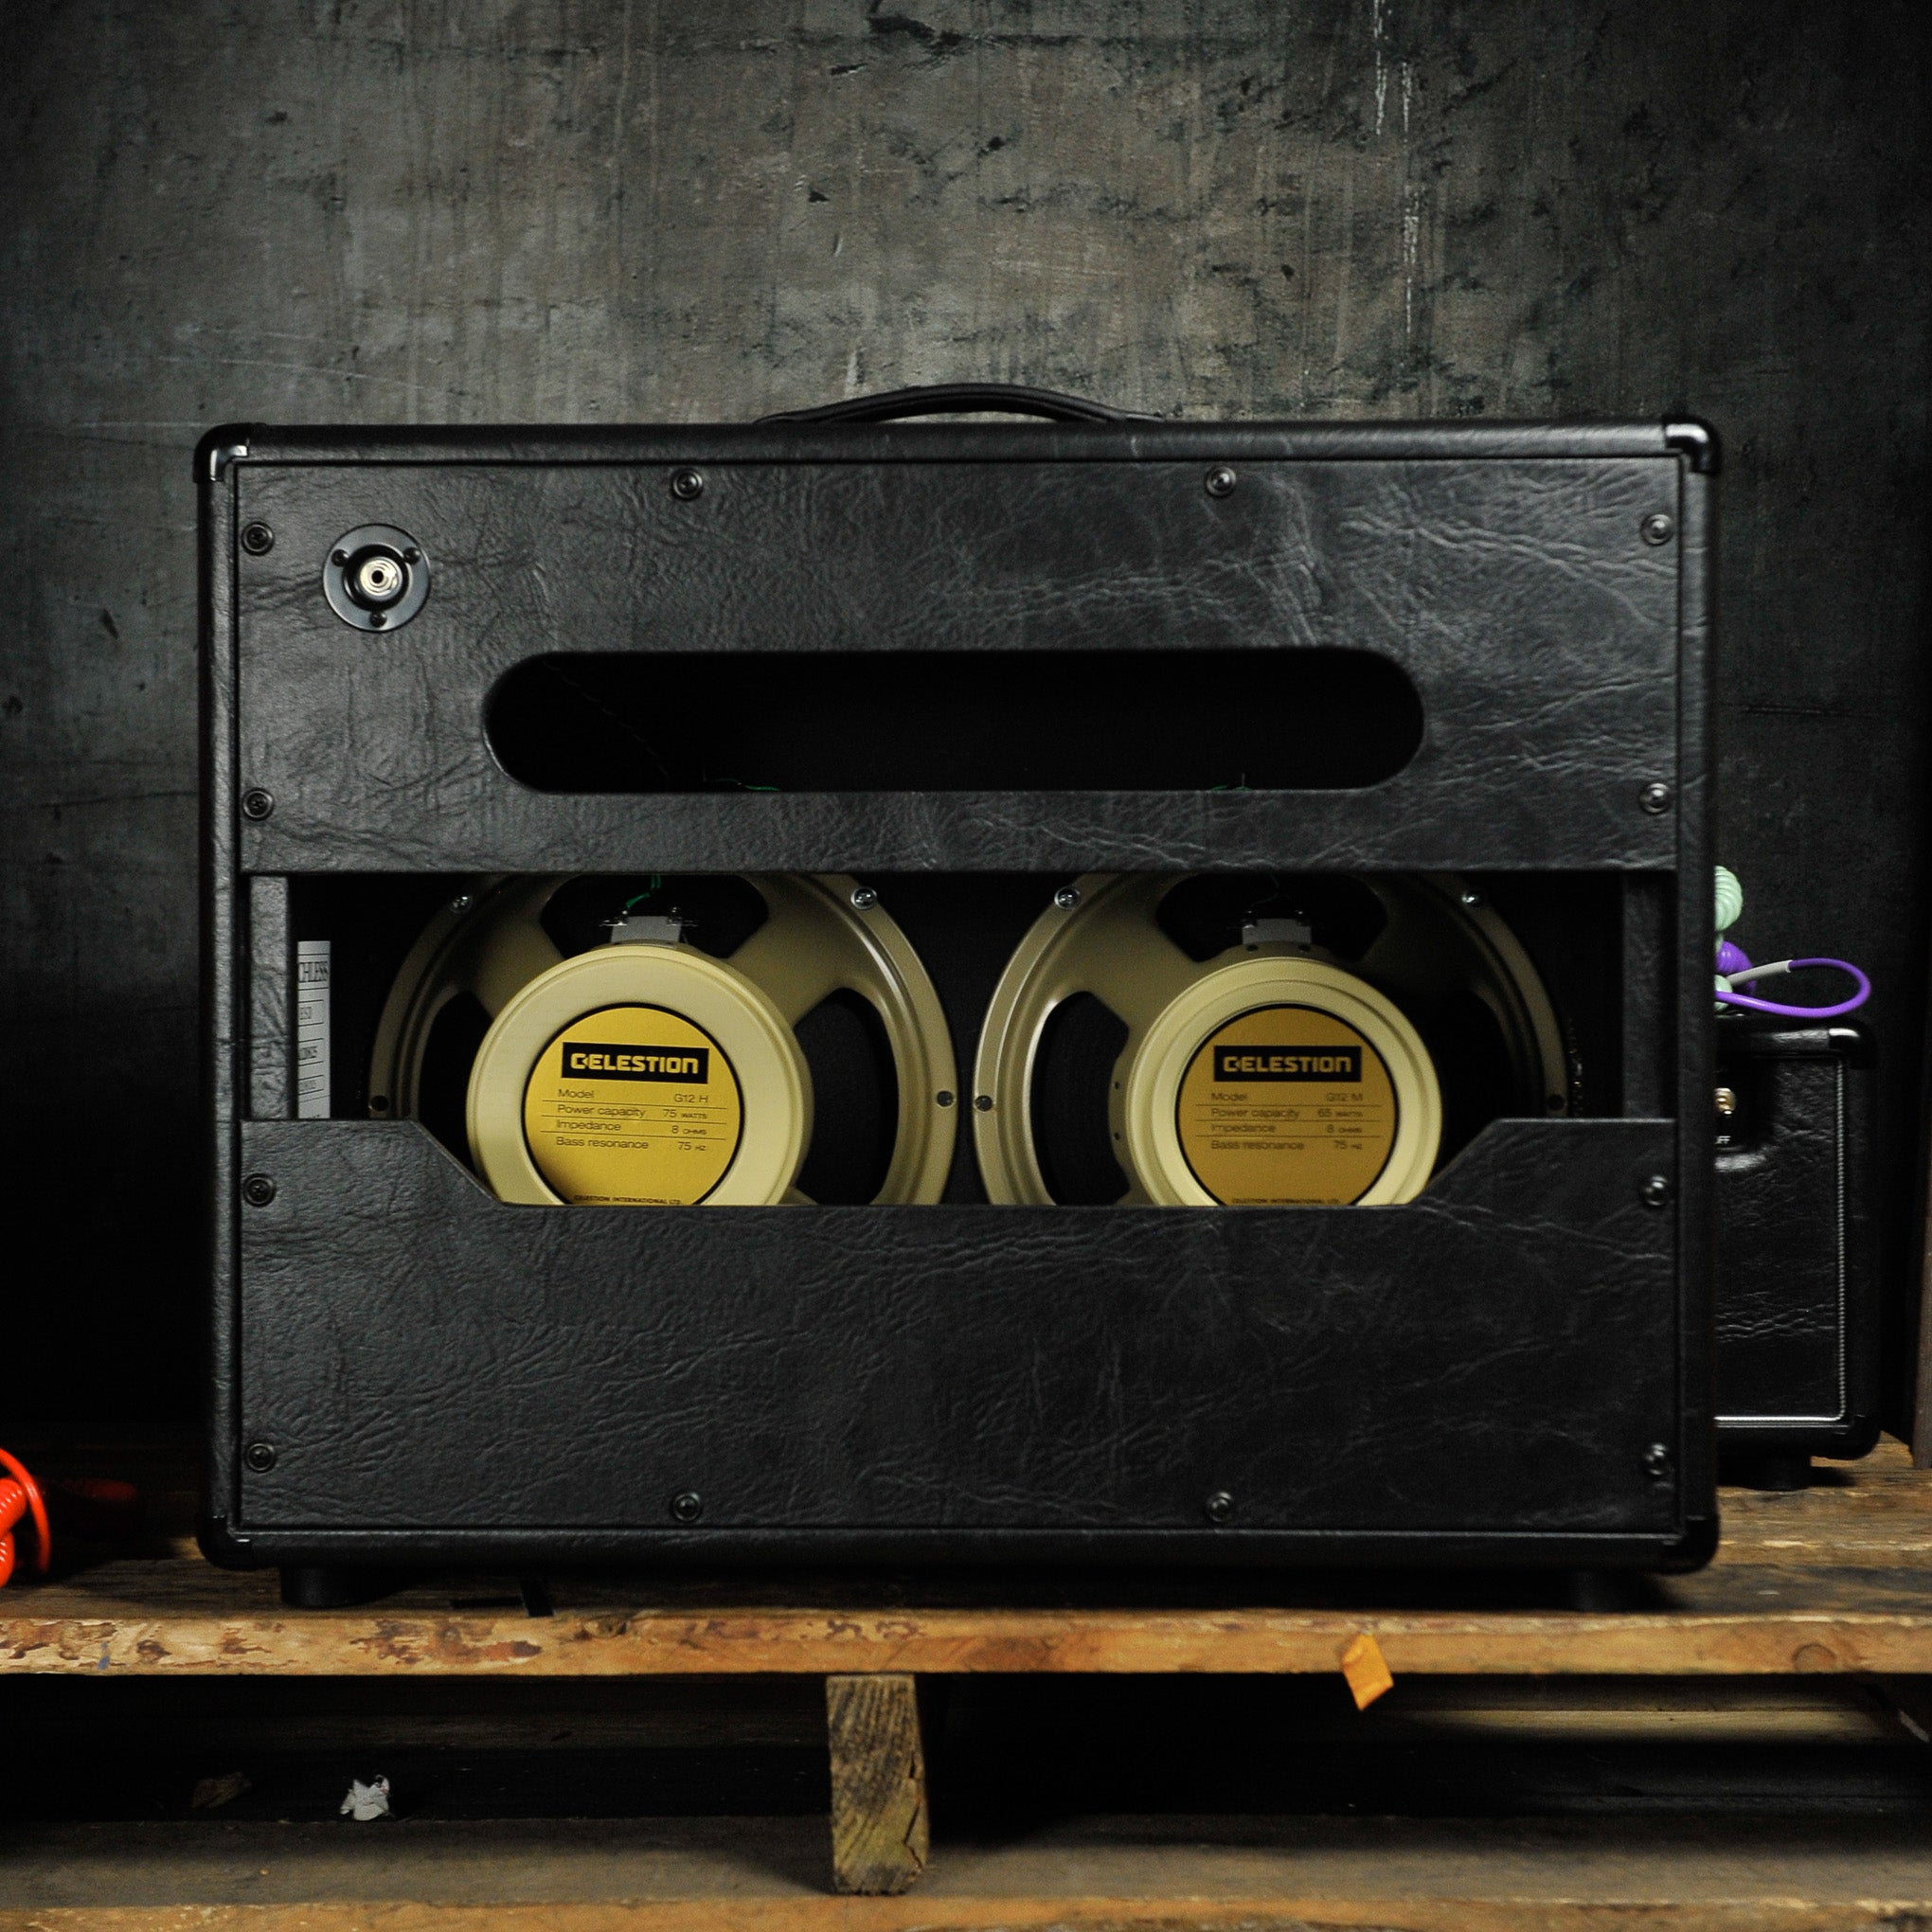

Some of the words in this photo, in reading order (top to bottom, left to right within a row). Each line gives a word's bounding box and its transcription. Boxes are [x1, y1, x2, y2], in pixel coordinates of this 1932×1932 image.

[571, 1053, 699, 1074] CELESTION
[1222, 1055, 1352, 1073] CELESTION
[557, 1089, 594, 1098] Model
[674, 1093, 695, 1103] G12
[698, 1094, 709, 1103] H
[1211, 1092, 1248, 1102] Model
[1352, 1092, 1363, 1102] M
[557, 1104, 594, 1114] Power
[597, 1106, 645, 1119] capacity
[662, 1109, 678, 1118] 75
[1211, 1109, 1249, 1117] Power
[1252, 1109, 1301, 1120] capacity
[556, 1120, 622, 1133] Impedance
[671, 1125, 679, 1134] 8
[1211, 1124, 1277, 1135] Impedance
[556, 1137, 586, 1147] Bass
[588, 1139, 649, 1150] resonance
[678, 1142, 692, 1151] 75
[1211, 1140, 1240, 1150] Bass
[1243, 1141, 1305, 1150] resonance
[1334, 1141, 1347, 1149] 75
